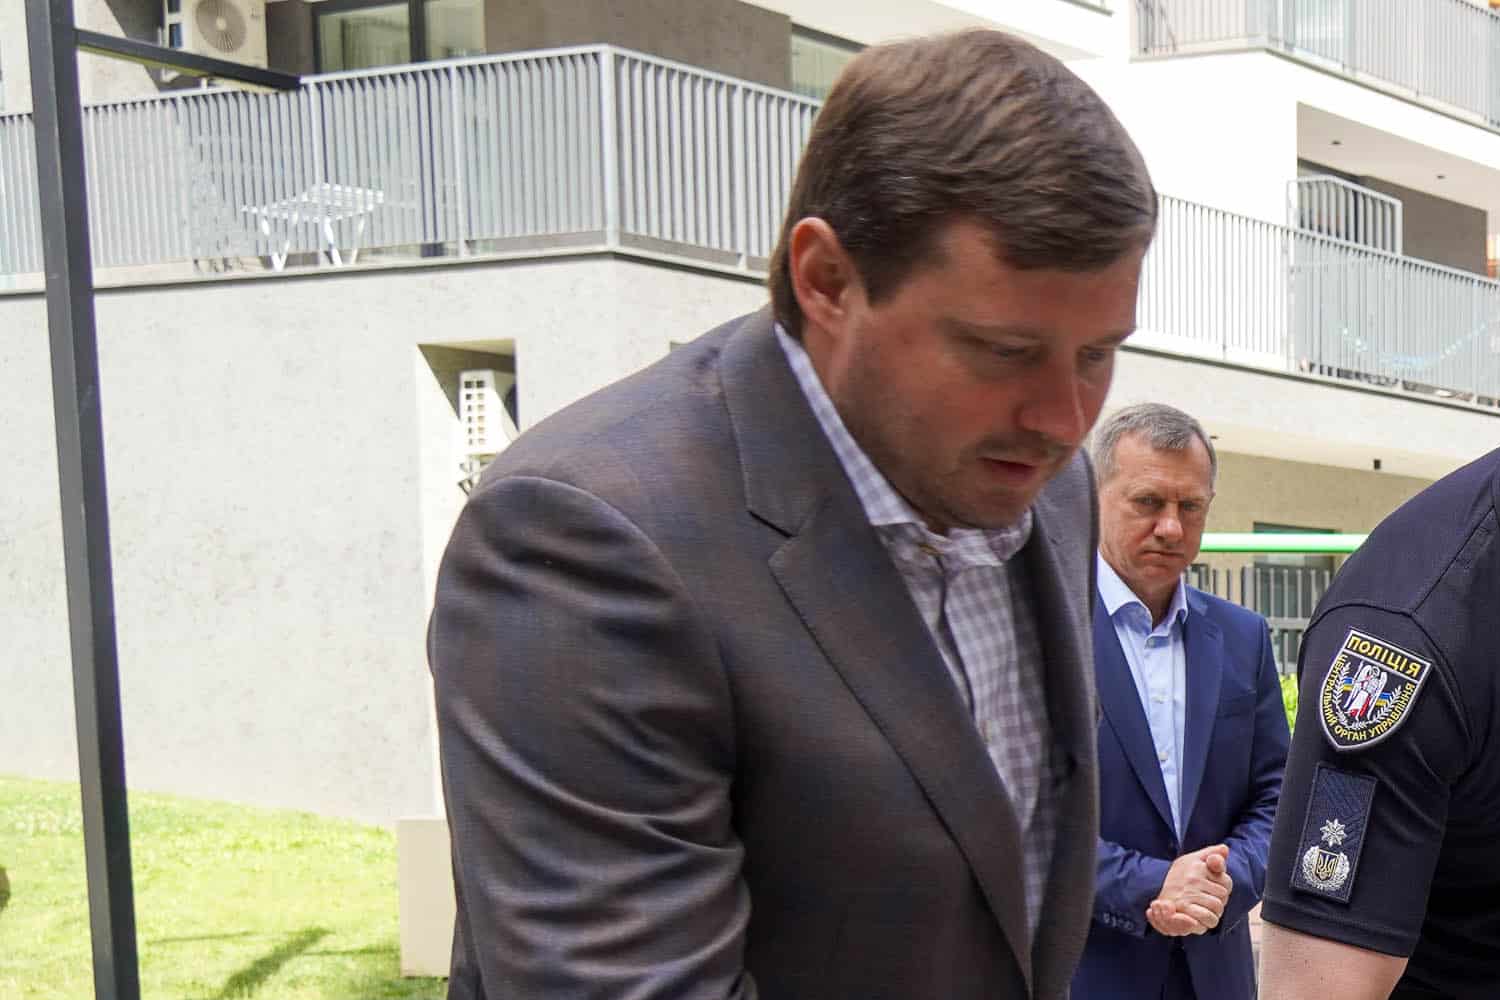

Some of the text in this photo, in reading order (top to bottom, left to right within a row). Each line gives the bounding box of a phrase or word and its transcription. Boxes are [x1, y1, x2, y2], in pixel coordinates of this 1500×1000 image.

[1348, 636, 1421, 677] ПОЛІЦІЯ
[1323, 654, 1415, 741] ЦЕНТРАЛЬНИЙ ОРГАН УПРАВЛІННЯ
